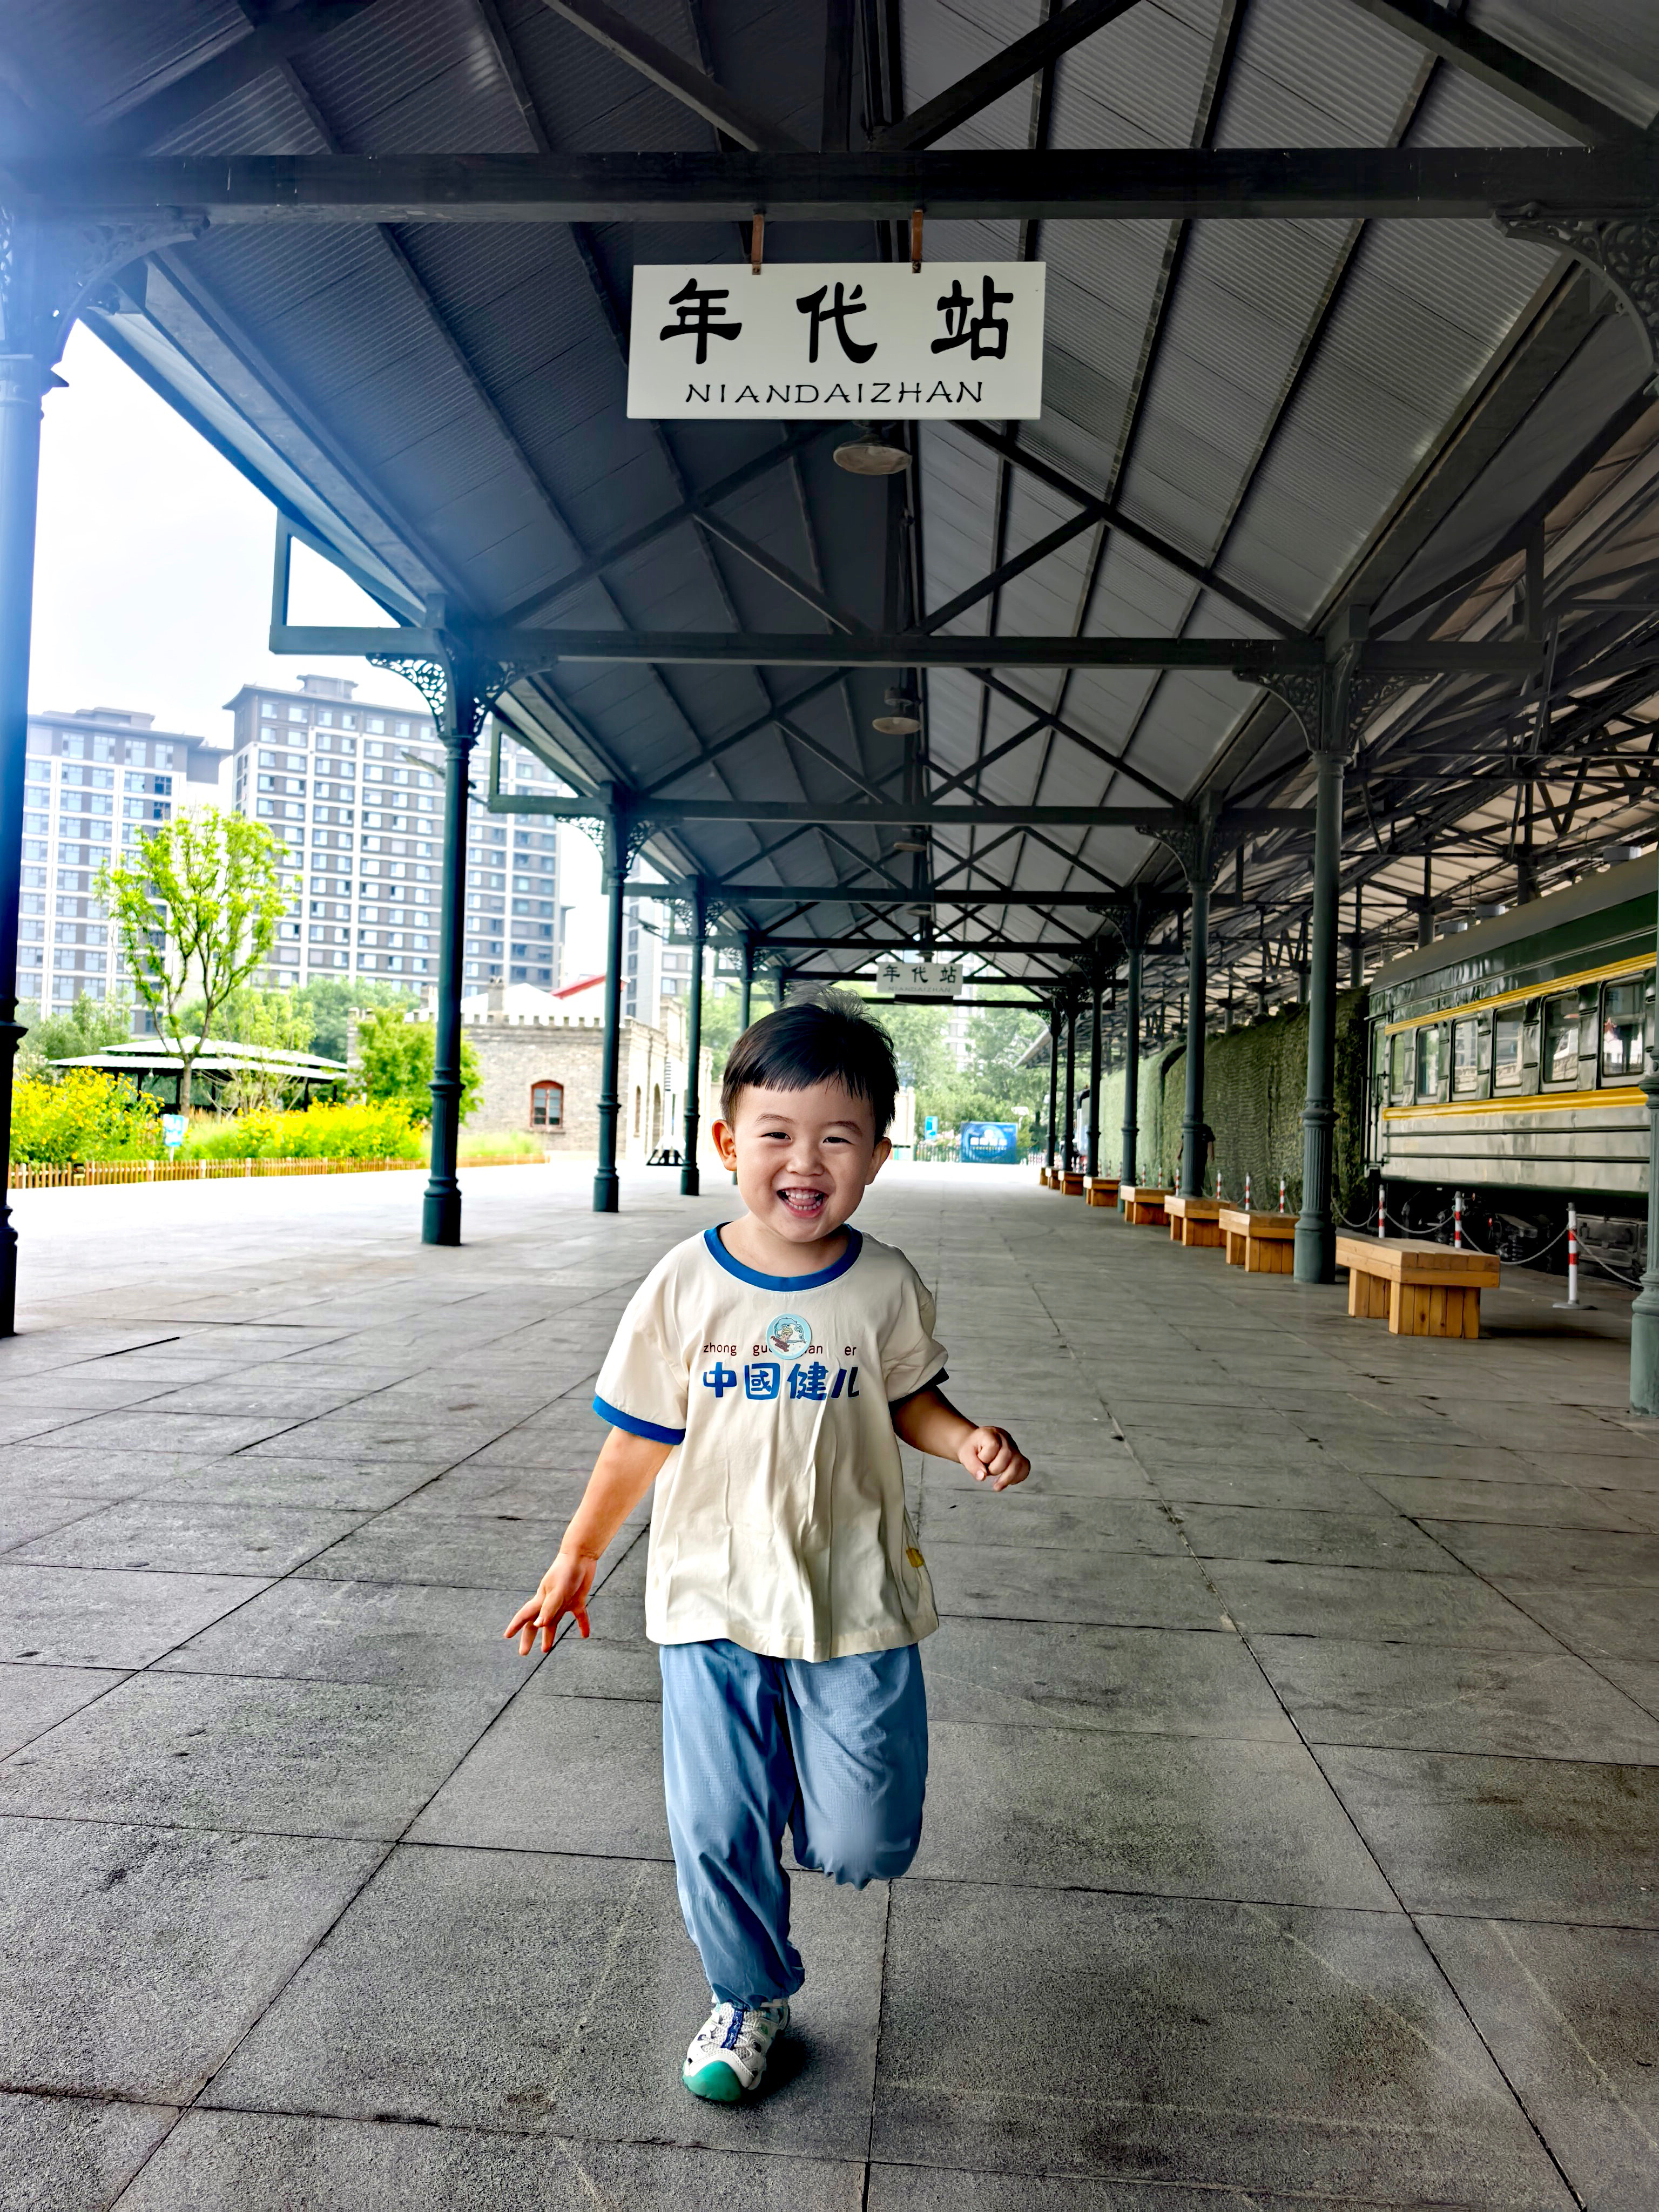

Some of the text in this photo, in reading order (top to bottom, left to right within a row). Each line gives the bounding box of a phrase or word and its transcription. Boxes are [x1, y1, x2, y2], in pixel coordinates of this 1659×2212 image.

[659, 275, 1014, 365] 年代站
[685, 381, 984, 404] NIANDAIZHAN
[882, 964, 957, 983] 年代站
[703, 1343, 737, 1356] zhong
[753, 1344, 772, 1357] gu
[844, 1345, 857, 1356] er
[703, 1361, 860, 1401] 中國健儿
